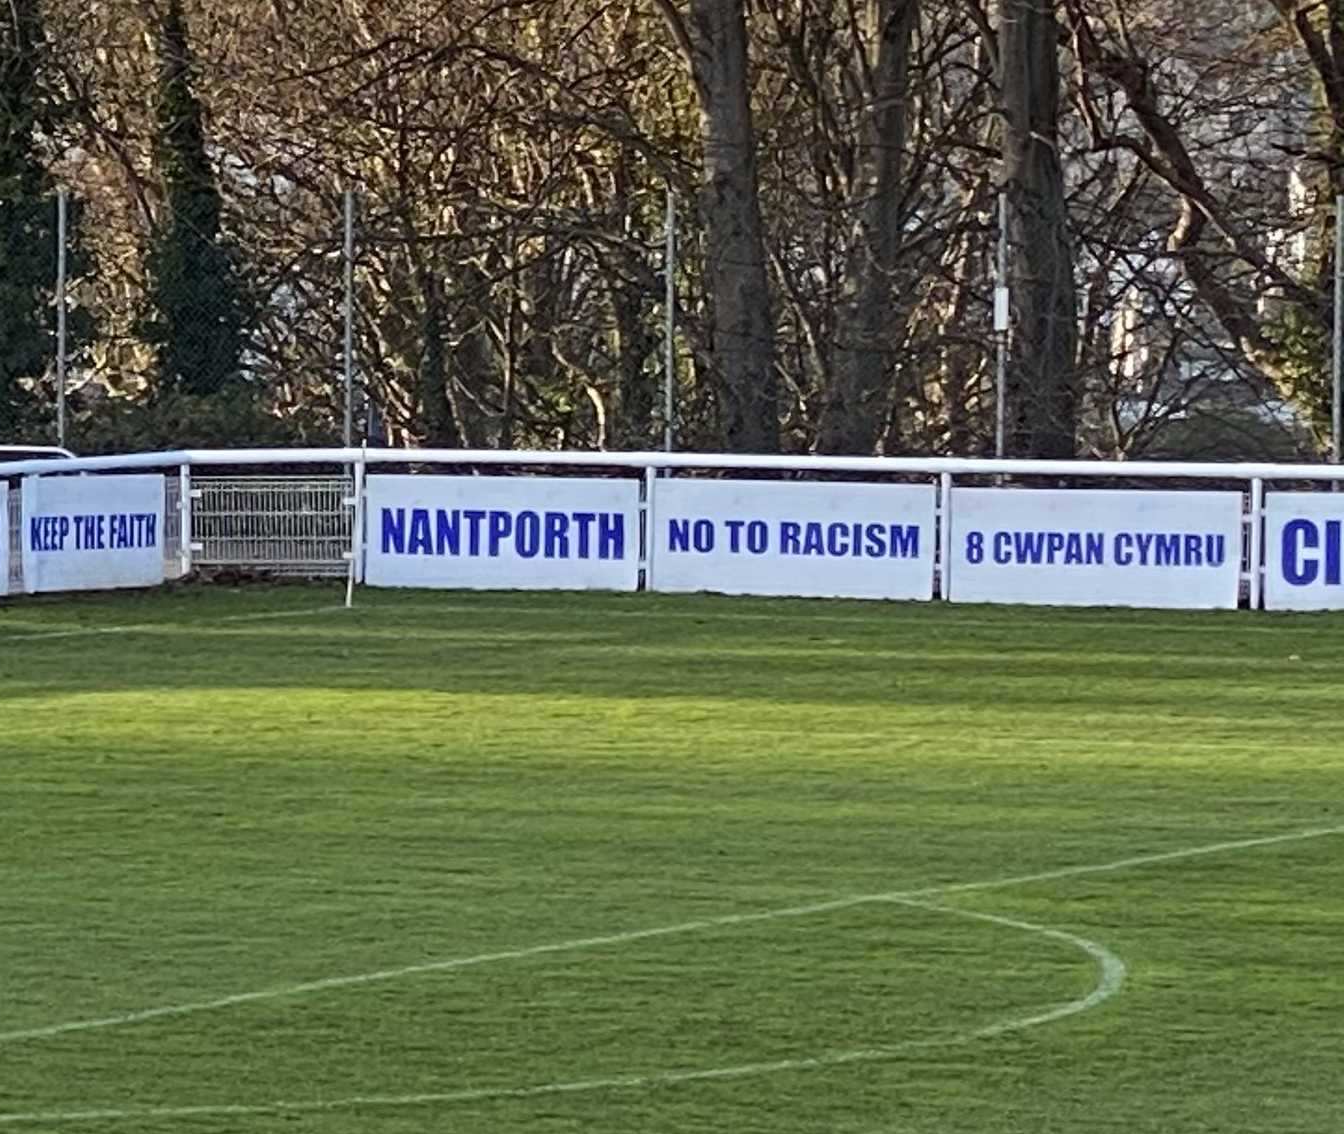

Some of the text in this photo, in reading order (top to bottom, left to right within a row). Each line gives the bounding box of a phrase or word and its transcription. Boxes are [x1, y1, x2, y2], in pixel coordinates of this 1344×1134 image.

[30, 512, 157, 552] KEEP THE FAITH
[381, 507, 625, 560] NANTPORTH
[668, 518, 920, 558] NO TO RACISM
[966, 531, 1225, 567] 8 CWPAN CYMRU
[1281, 518, 1342, 586] CI
